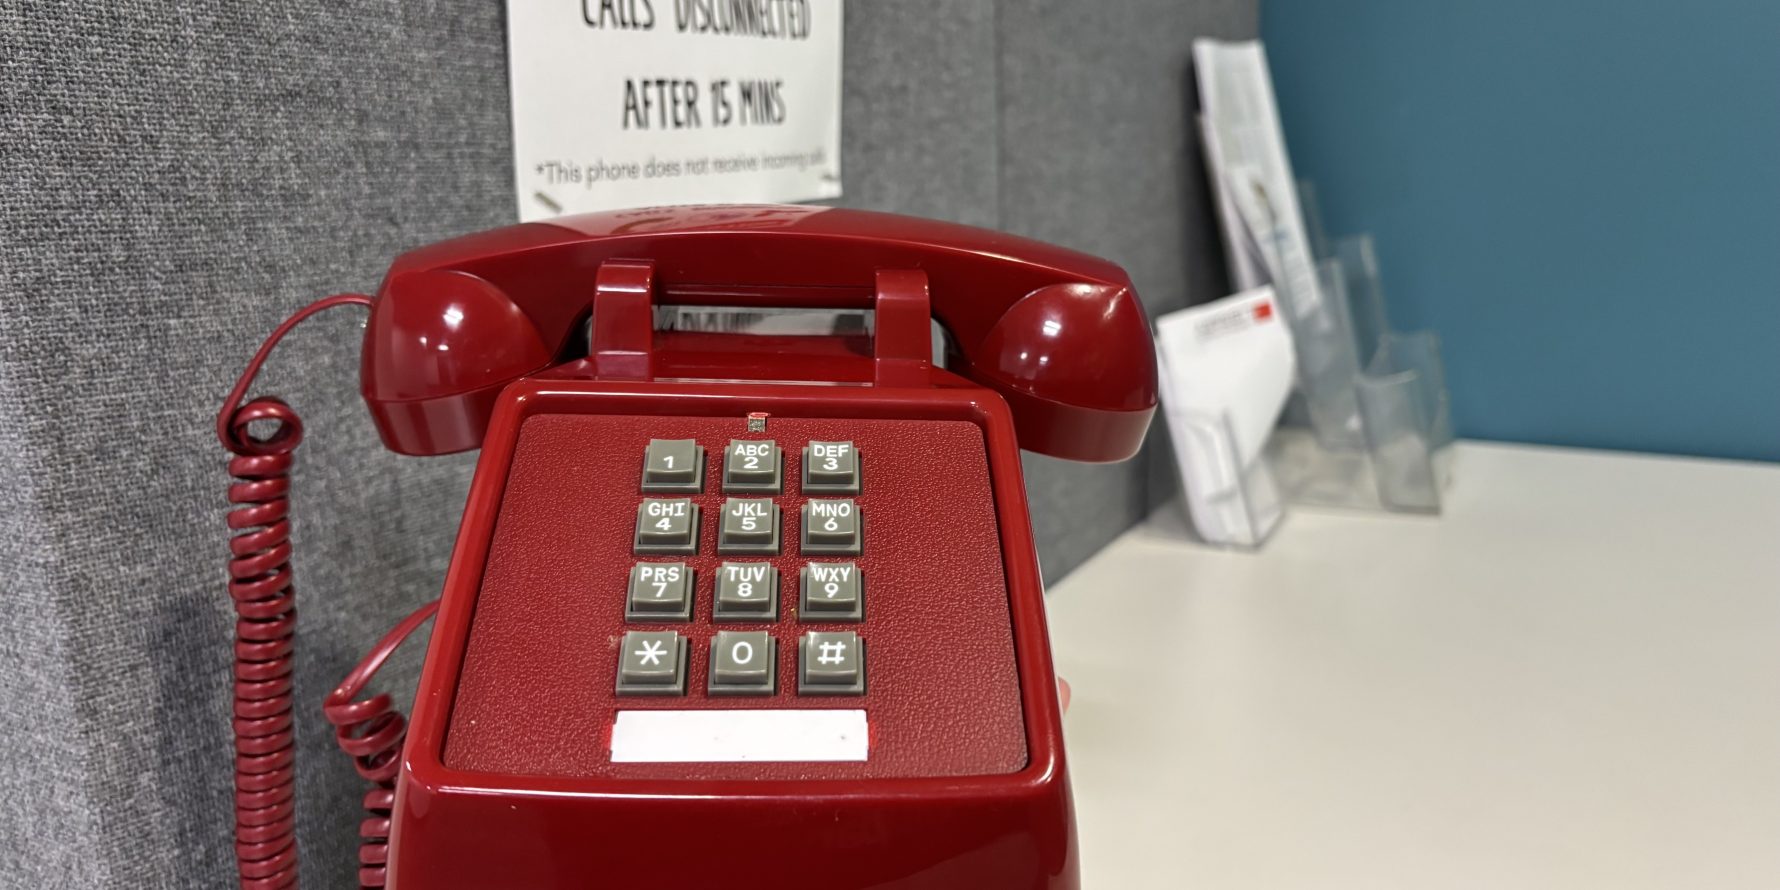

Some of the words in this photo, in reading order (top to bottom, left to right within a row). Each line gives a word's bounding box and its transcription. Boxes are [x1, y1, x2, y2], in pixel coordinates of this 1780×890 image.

[582, 0, 655, 30] CALLS
[675, 0, 811, 39] DISCONNECTED
[622, 79, 702, 130] AFTER
[711, 79, 732, 127] 15
[738, 80, 787, 127] MINS
[587, 157, 640, 189] phone
[643, 155, 682, 178] does
[684, 156, 708, 176] not
[712, 153, 759, 173] receive
[735, 444, 769, 457] ABC
[813, 444, 849, 457] DEF
[663, 456, 675, 469] 1
[743, 457, 759, 469] 2
[823, 458, 838, 470] 3
[648, 502, 685, 517] GHI
[732, 503, 767, 517] JKL
[812, 503, 850, 517] MNO
[656, 518, 671, 531] 4
[742, 518, 756, 531] 5
[824, 518, 838, 531] 6
[640, 567, 679, 582] PRS
[727, 567, 765, 582] TUV
[813, 567, 851, 582] WXY
[652, 583, 667, 597] 7
[737, 583, 753, 597] 8
[824, 583, 839, 598] 9
[732, 641, 753, 664] 0
